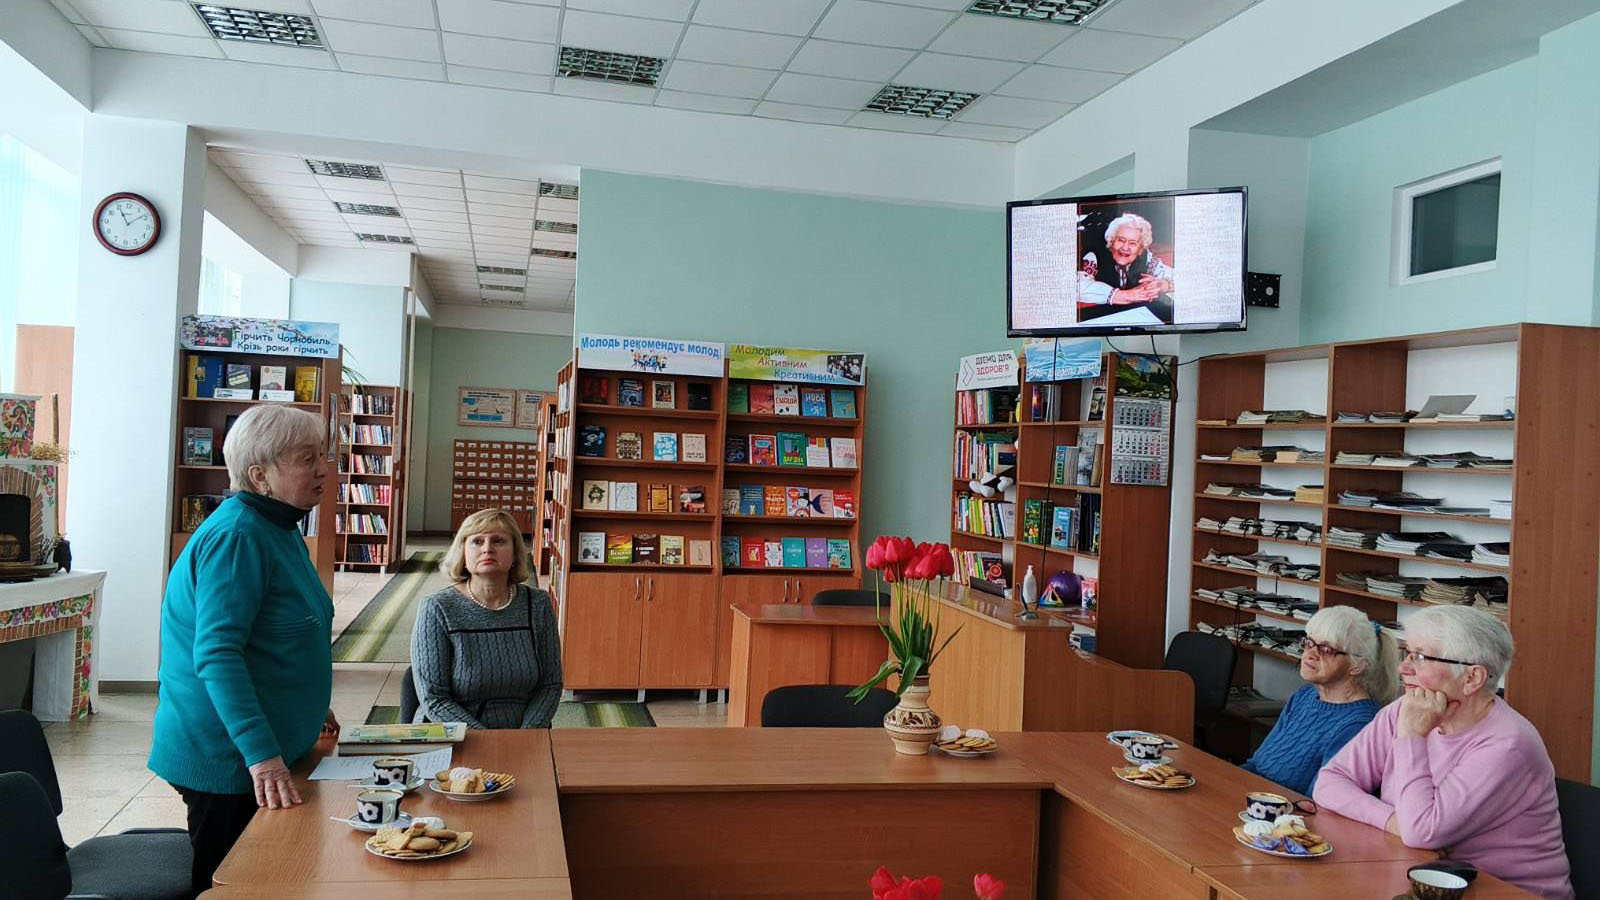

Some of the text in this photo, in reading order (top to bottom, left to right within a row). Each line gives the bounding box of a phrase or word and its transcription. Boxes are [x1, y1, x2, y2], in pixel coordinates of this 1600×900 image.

[234, 330, 273, 342] Гірчить
[237, 341, 329, 355] Крізь роки гірчить
[581, 337, 620, 351] Молодь
[623, 338, 685, 354] рекомендує
[735, 345, 785, 356] Молодим
[757, 357, 808, 369] Активним
[998, 353, 1013, 363] ДЛЯ
[774, 368, 835, 381] Креативним
